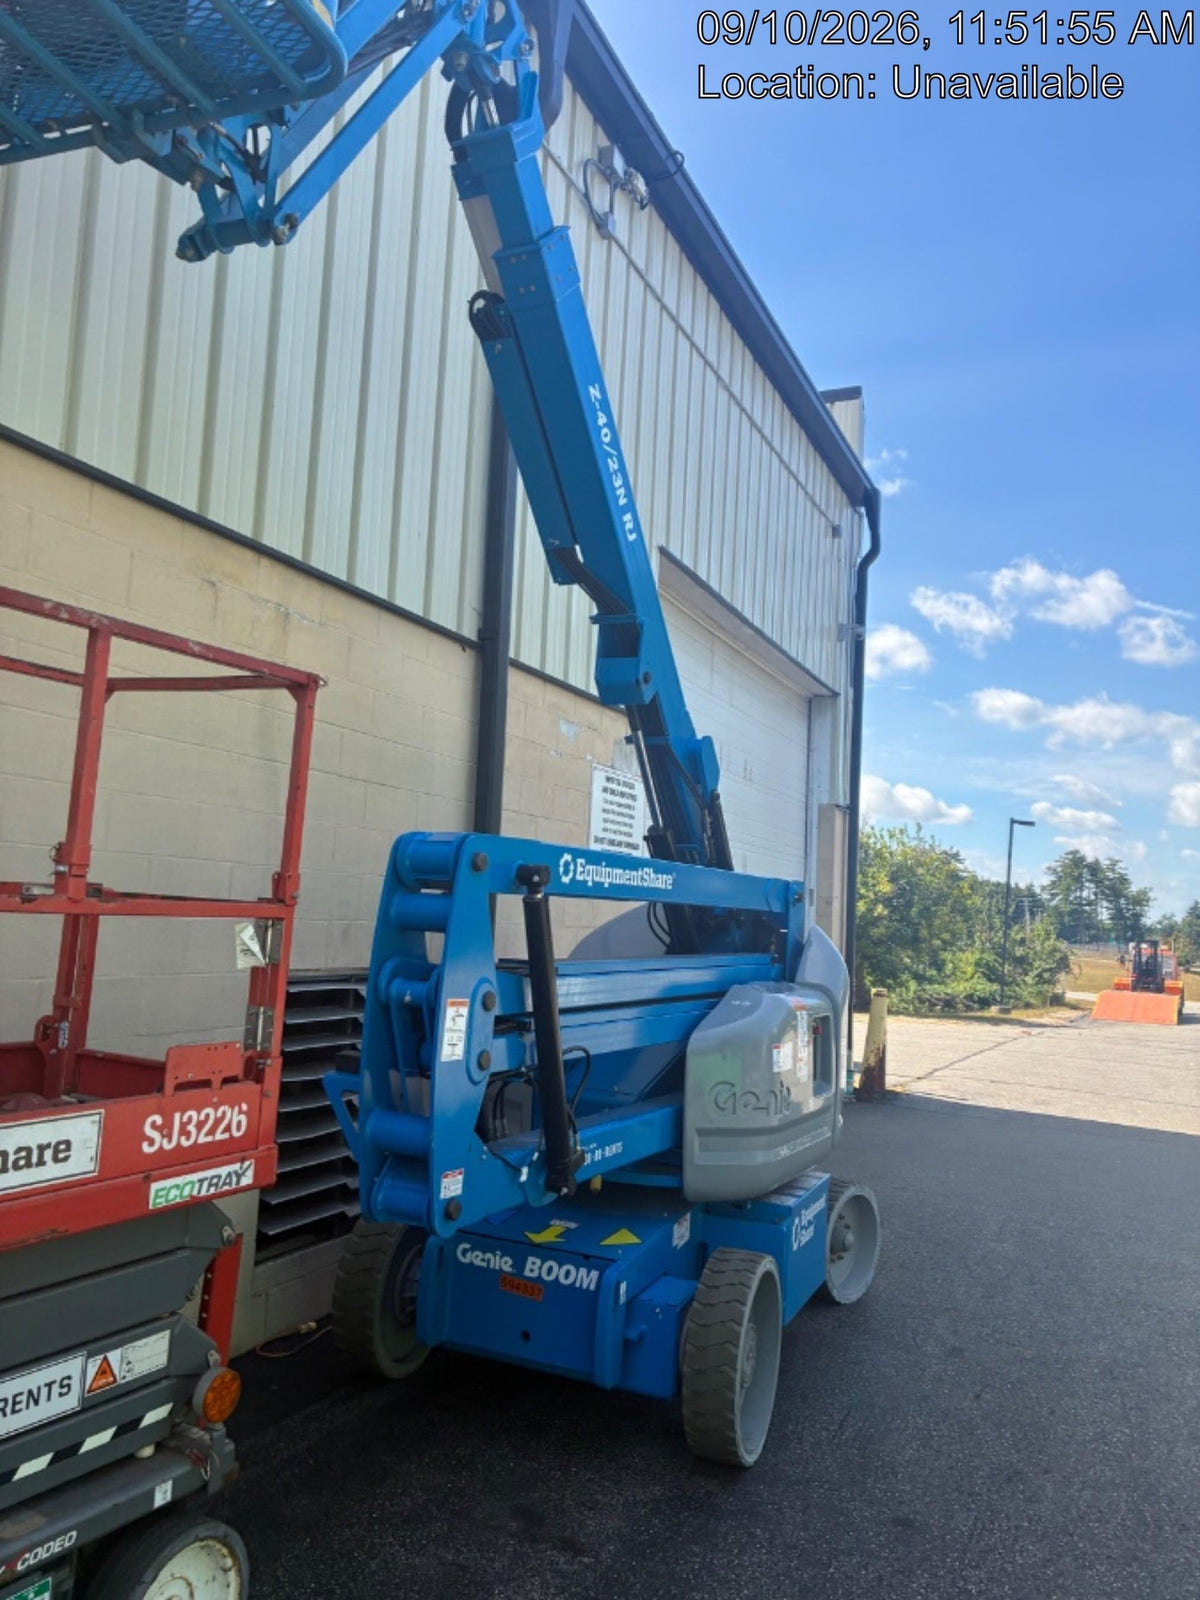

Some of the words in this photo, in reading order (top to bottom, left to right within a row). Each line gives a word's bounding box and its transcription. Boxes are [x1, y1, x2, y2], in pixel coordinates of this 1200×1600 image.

[588, 383, 628, 507] Z-40/23N
[622, 511, 638, 542] RJ
[575, 857, 673, 890] EquipmentShare
[141, 1102, 249, 1154] SJ3226
[152, 1162, 252, 1208] ECOTRAY
[456, 1243, 514, 1273] Genie
[523, 1256, 600, 1291] BOOM
[0, 1374, 72, 1418] RENTS
